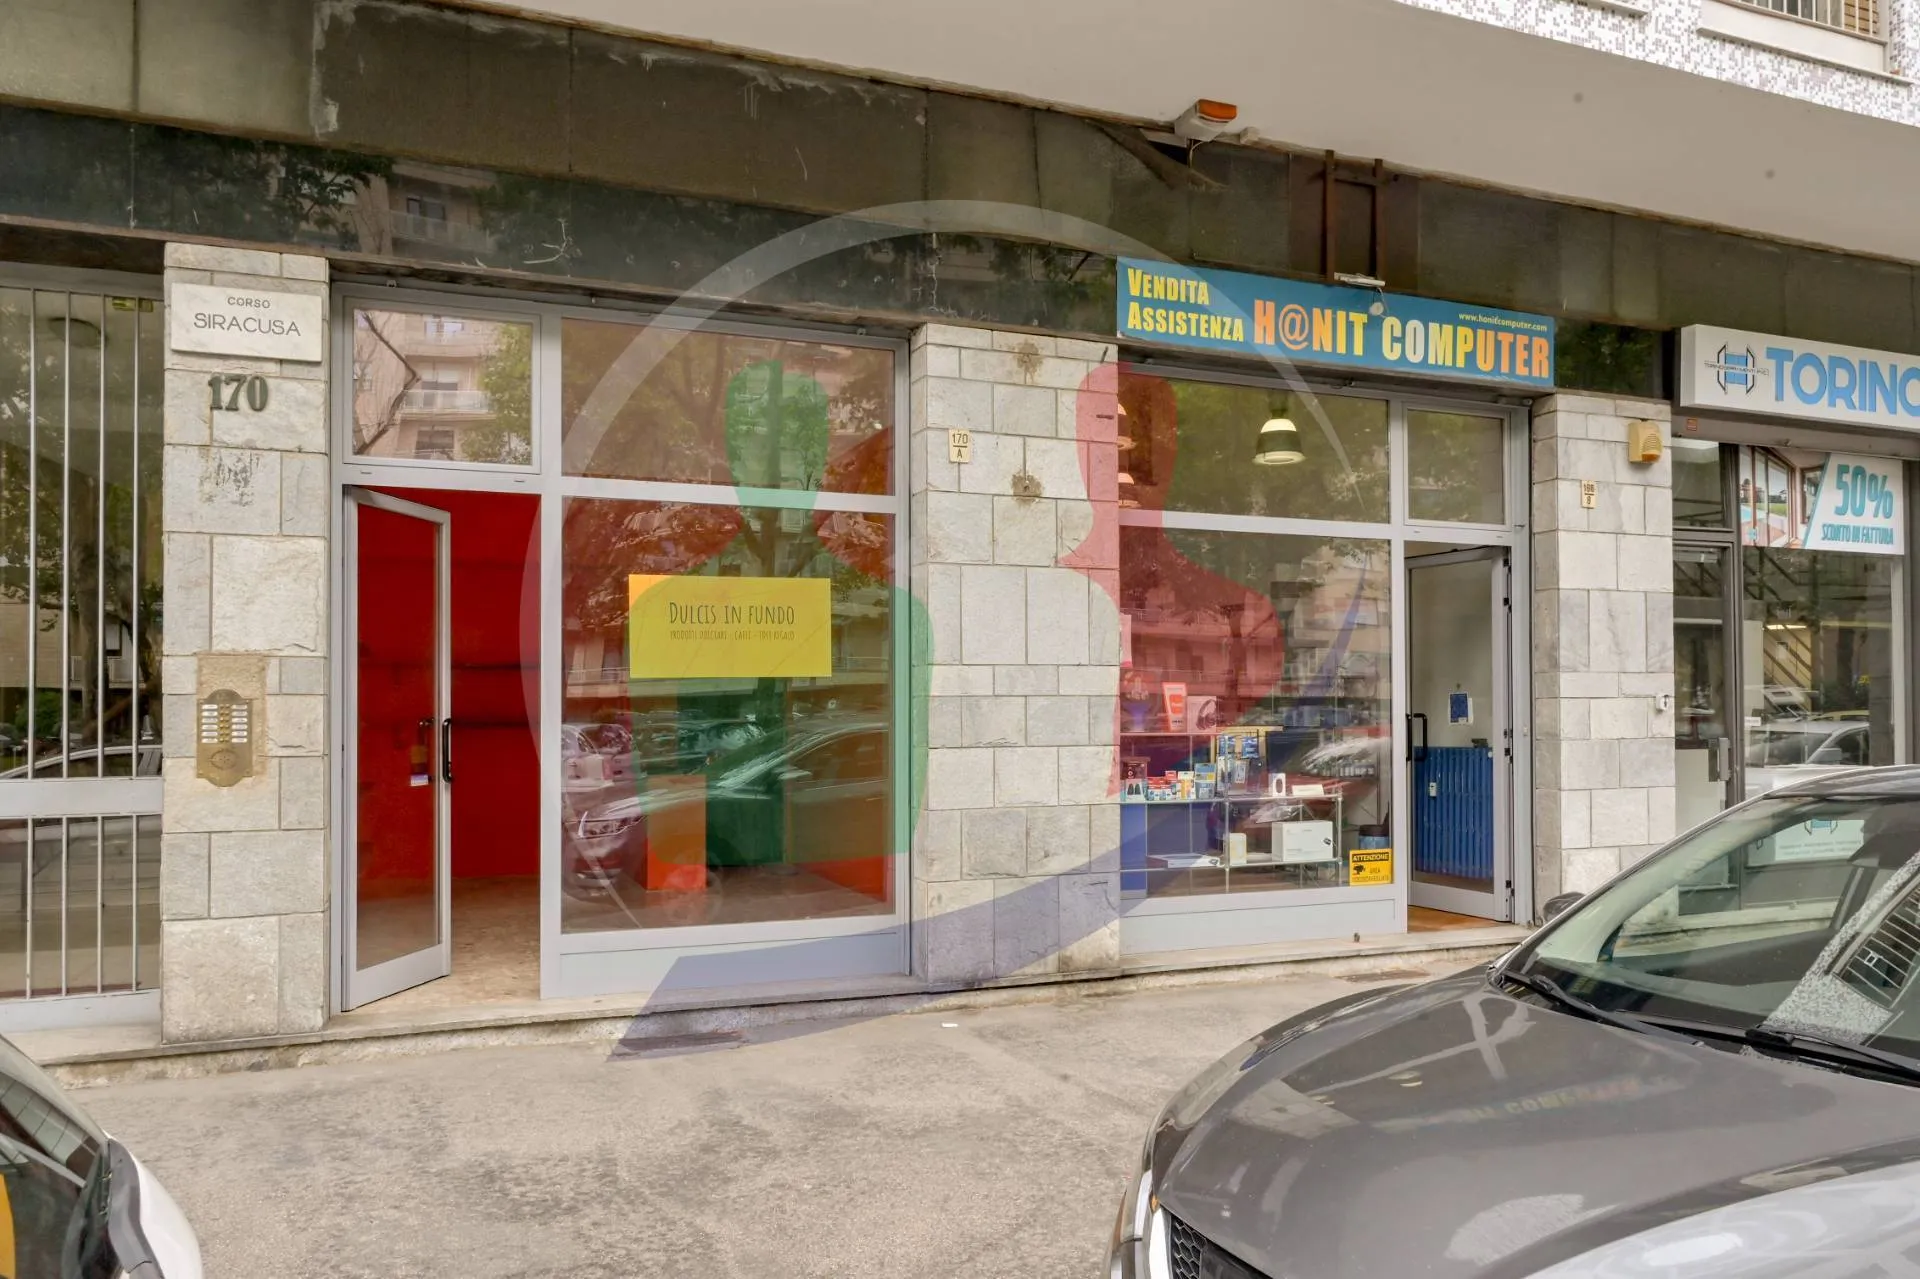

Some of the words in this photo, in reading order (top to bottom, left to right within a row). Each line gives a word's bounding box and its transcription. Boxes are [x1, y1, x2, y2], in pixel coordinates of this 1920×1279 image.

[1127, 267, 1210, 305] VENDITA
[227, 296, 271, 309] CORSO
[193, 312, 301, 337] SIRACUSA
[1127, 301, 1244, 342] ASSISTENZA
[1458, 312, 1547, 332] www.honitcomputer.com
[1254, 299, 1368, 356] H@NIT
[1382, 316, 1549, 378] COMPUTER
[208, 372, 268, 412] 170
[952, 433, 968, 444] 170
[956, 448, 963, 458] A
[1834, 463, 1894, 519] 50%
[669, 602, 716, 624] DULCIS
[724, 605, 742, 624] IN
[748, 604, 795, 624] FUNDO
[1353, 853, 1389, 861] ATTENZIONE
